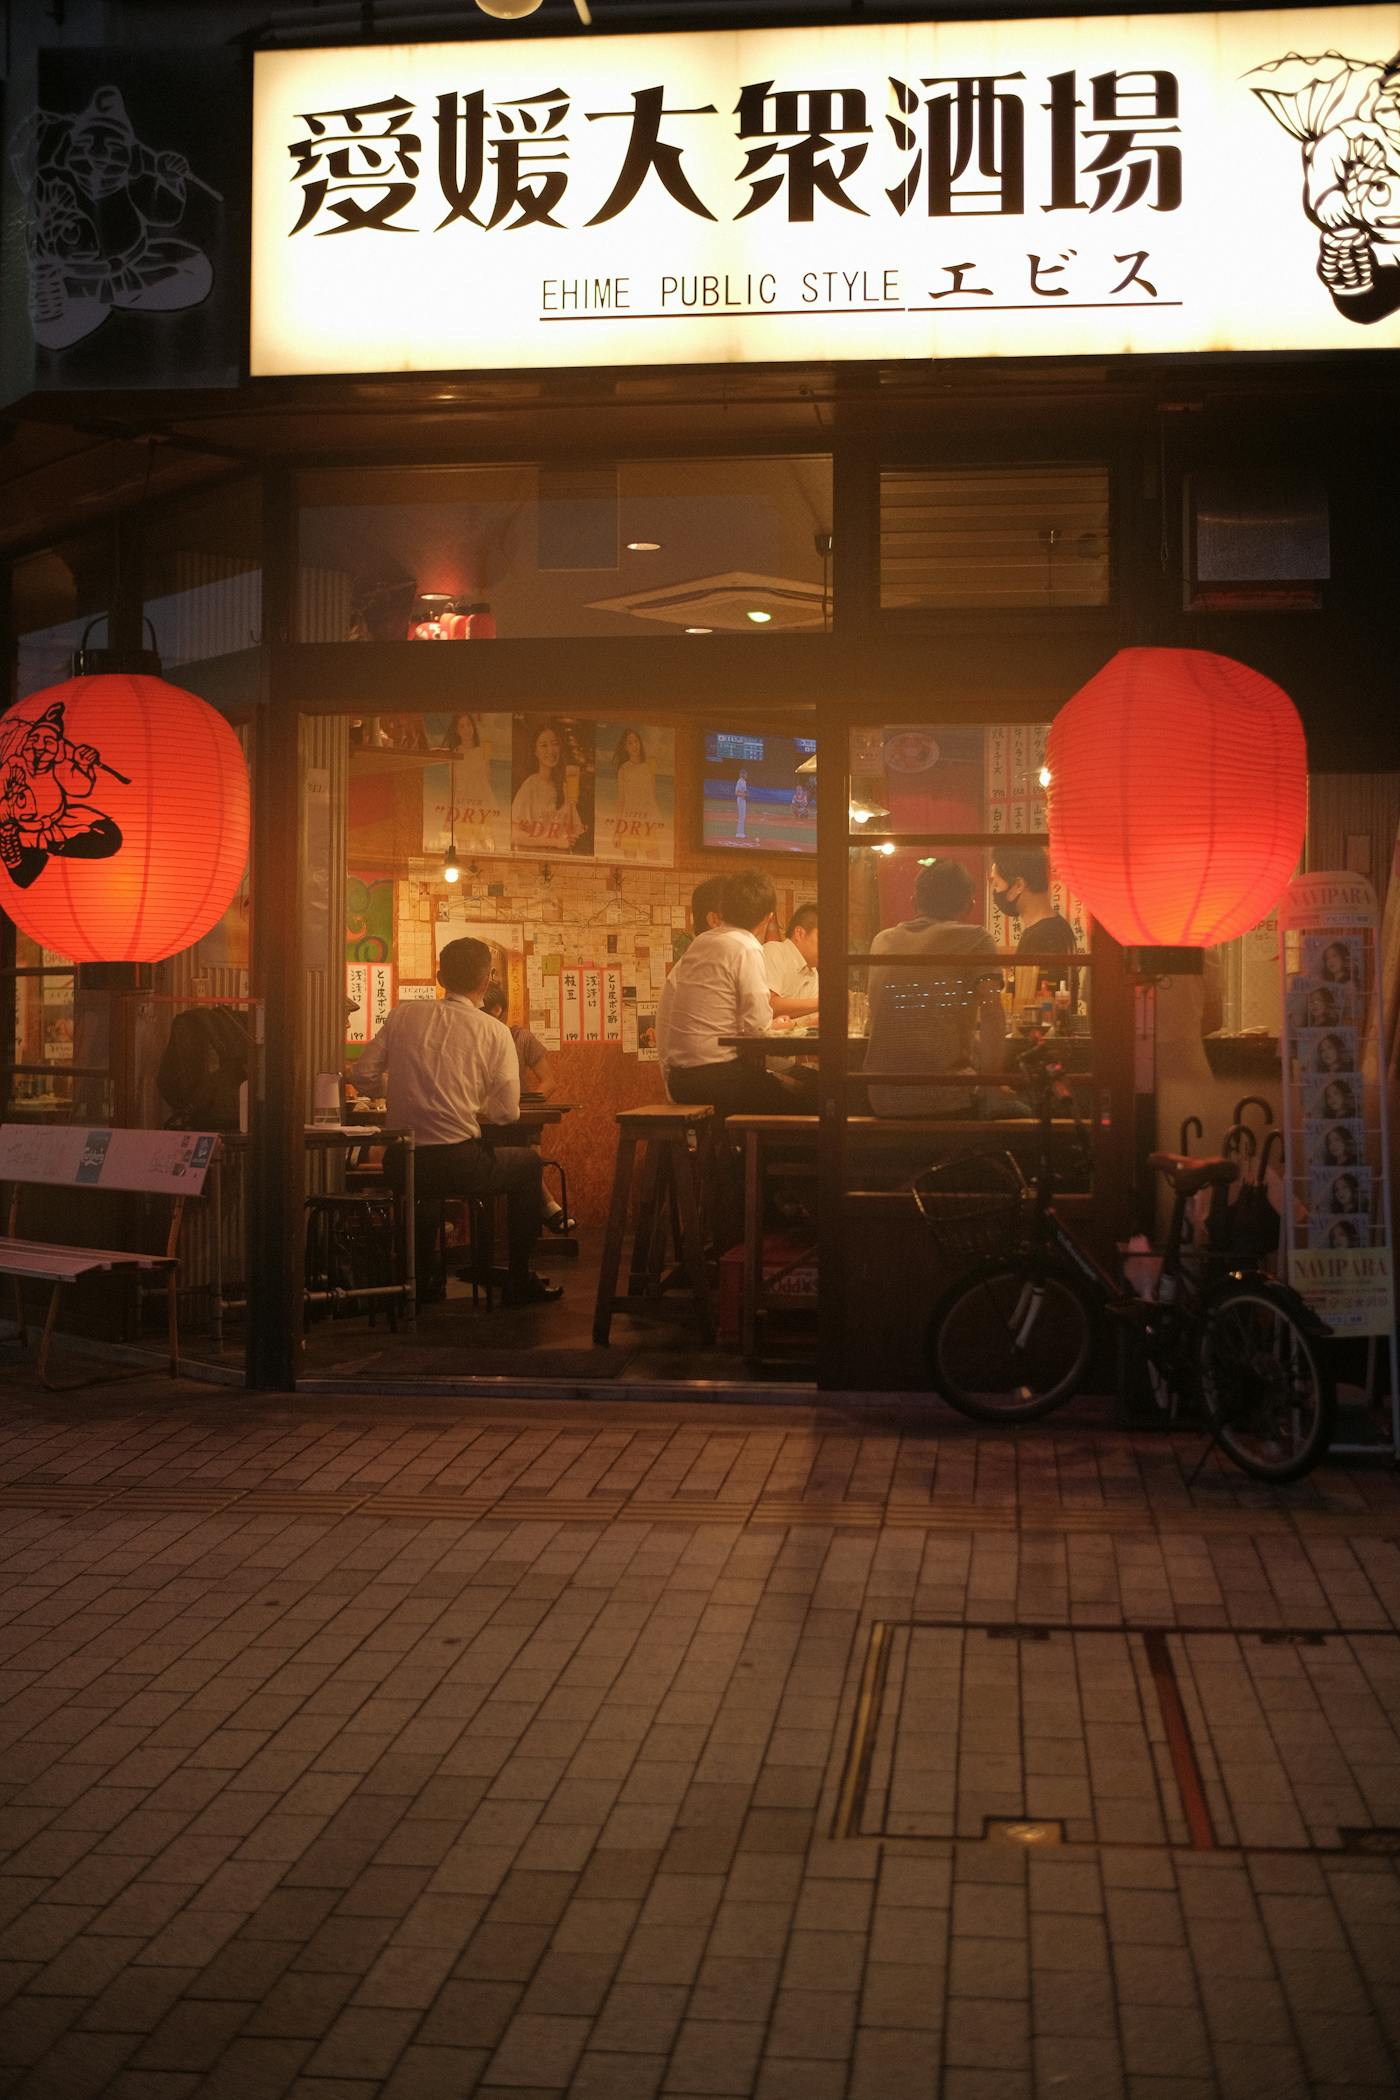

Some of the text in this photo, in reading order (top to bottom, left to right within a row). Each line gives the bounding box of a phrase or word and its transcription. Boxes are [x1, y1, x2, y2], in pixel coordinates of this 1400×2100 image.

[287, 69, 1182, 237] 愛媛大衆酒場
[542, 248, 1158, 311] EHIME PUBLIC STYLE エビス
